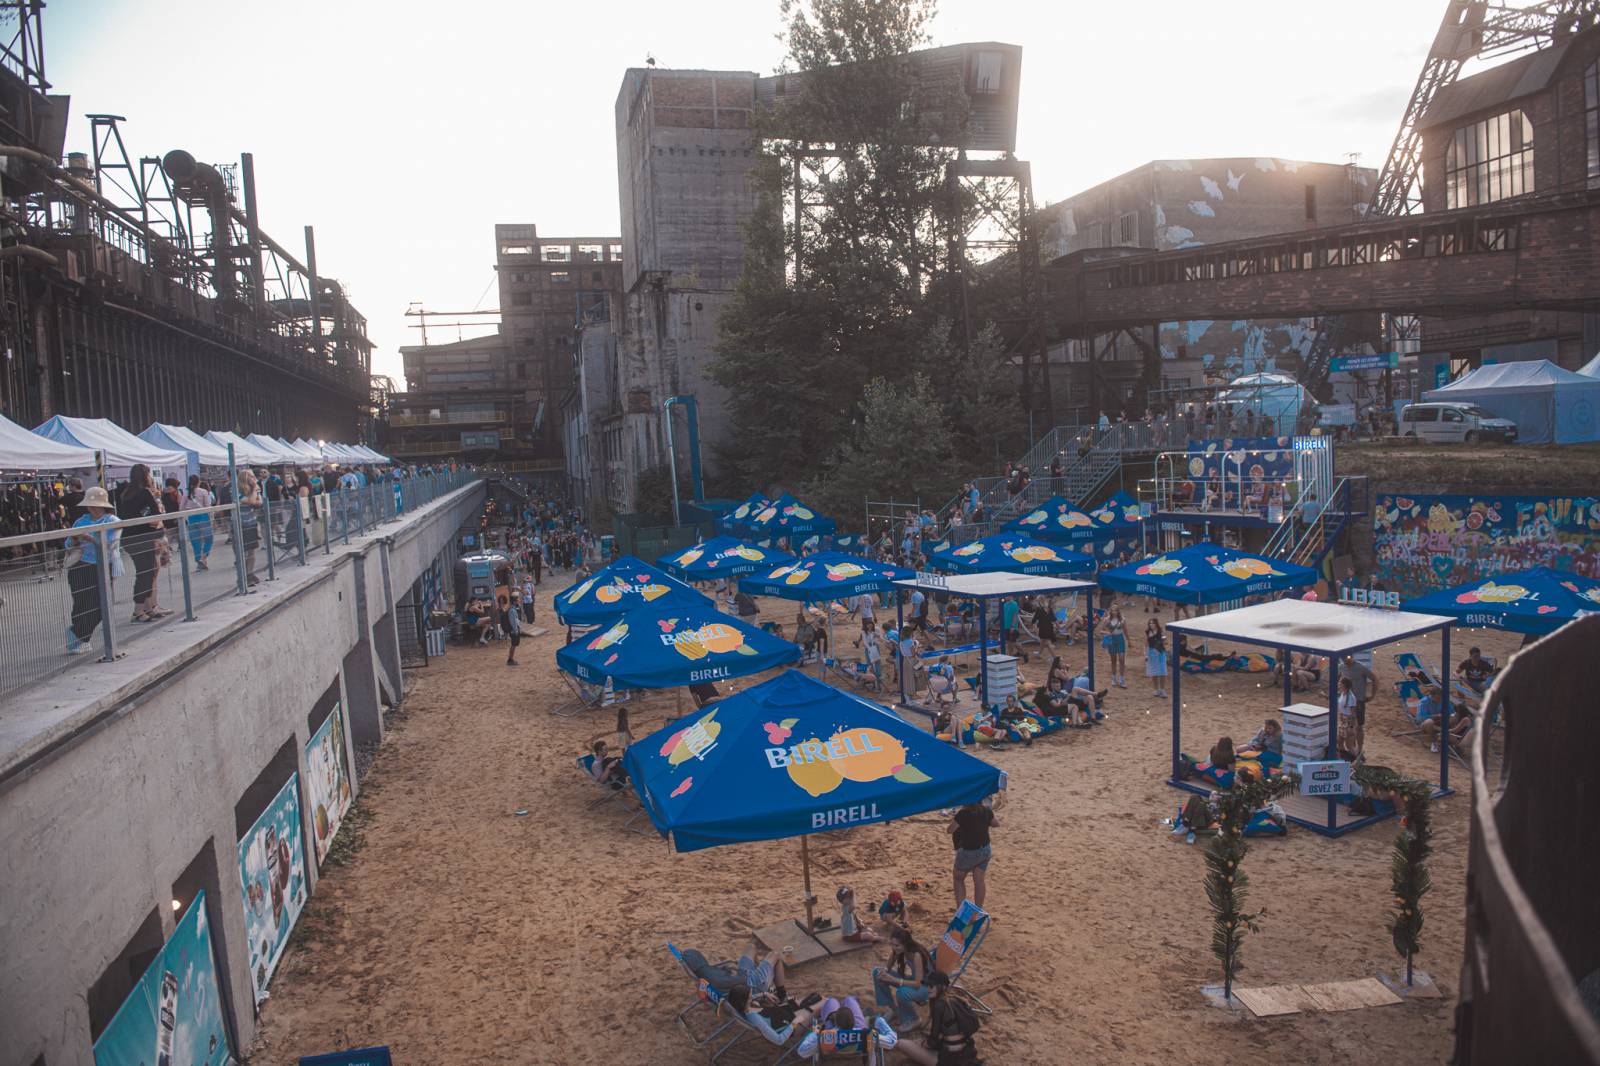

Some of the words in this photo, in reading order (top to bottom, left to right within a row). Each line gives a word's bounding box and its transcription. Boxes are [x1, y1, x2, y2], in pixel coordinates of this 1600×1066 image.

[1295, 439, 1326, 450] BIRELL
[1515, 497, 1600, 529] FRUITS
[855, 583, 880, 593] BIRELL
[1466, 614, 1505, 628] BIRELL
[659, 625, 730, 646] BIRELL
[690, 665, 732, 681] BIRELL
[765, 733, 883, 769] BIRELL
[1332, 783, 1344, 792] SE
[812, 803, 882, 829] BIRELL
